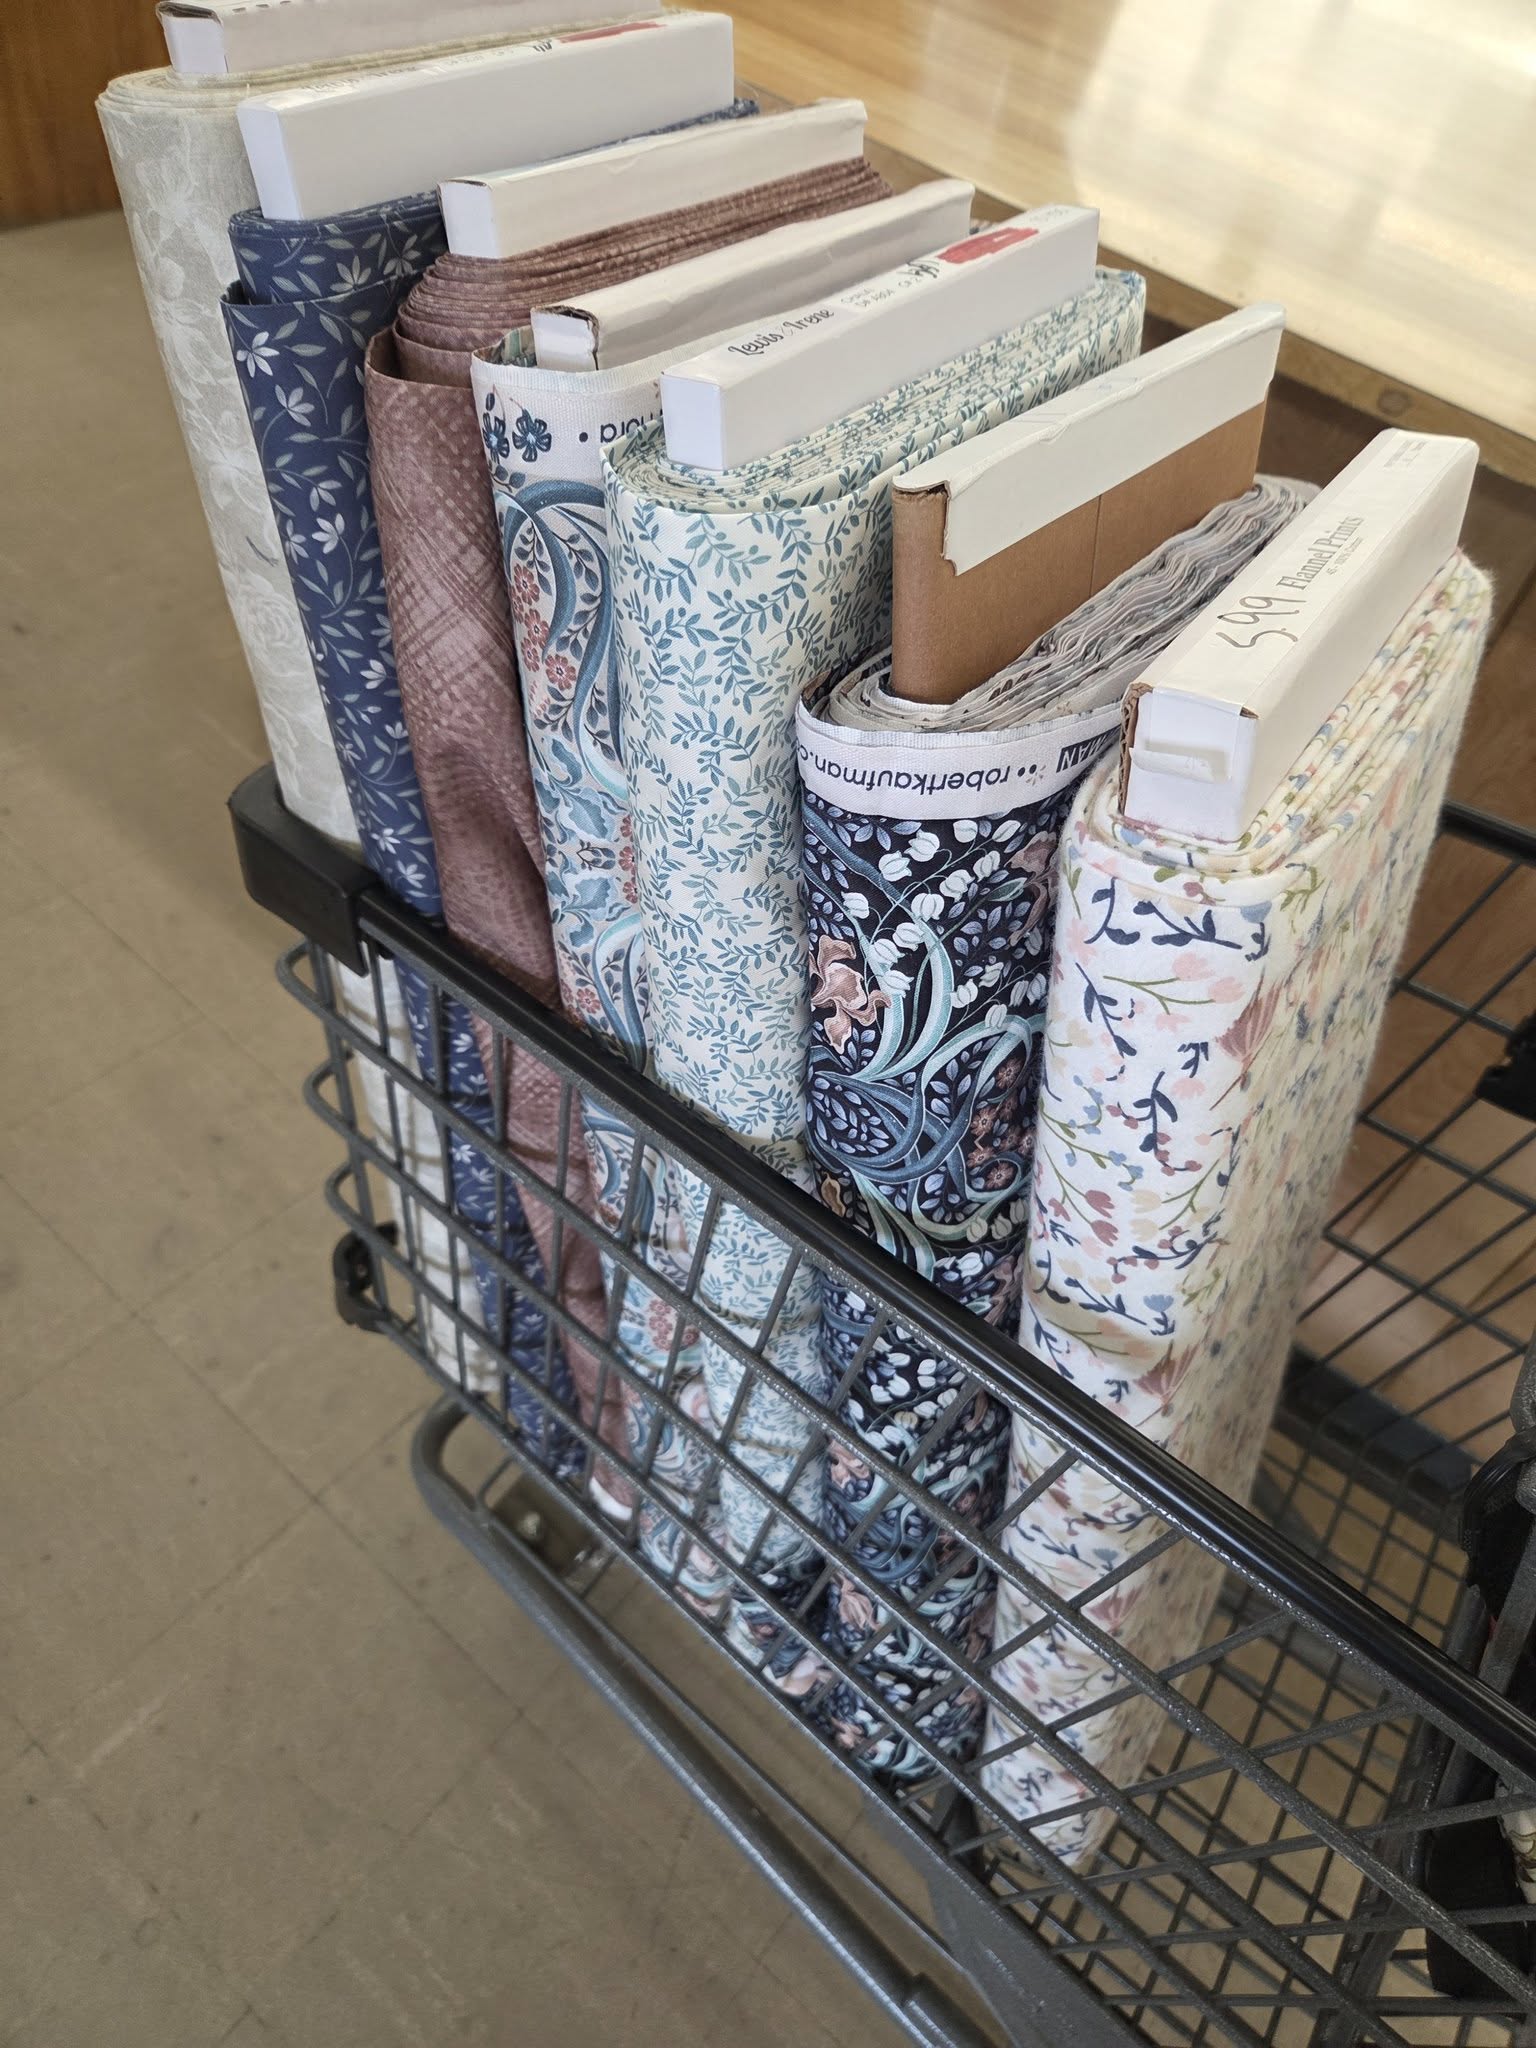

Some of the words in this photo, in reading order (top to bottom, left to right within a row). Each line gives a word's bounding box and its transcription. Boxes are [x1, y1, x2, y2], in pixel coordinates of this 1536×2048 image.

[727, 333, 785, 356] Lewis
[782, 308, 835, 331] Irene
[1275, 546, 1336, 591] Flannel
[1312, 516, 1366, 549] Prints
[797, 744, 1011, 796] robertkaufman.c
